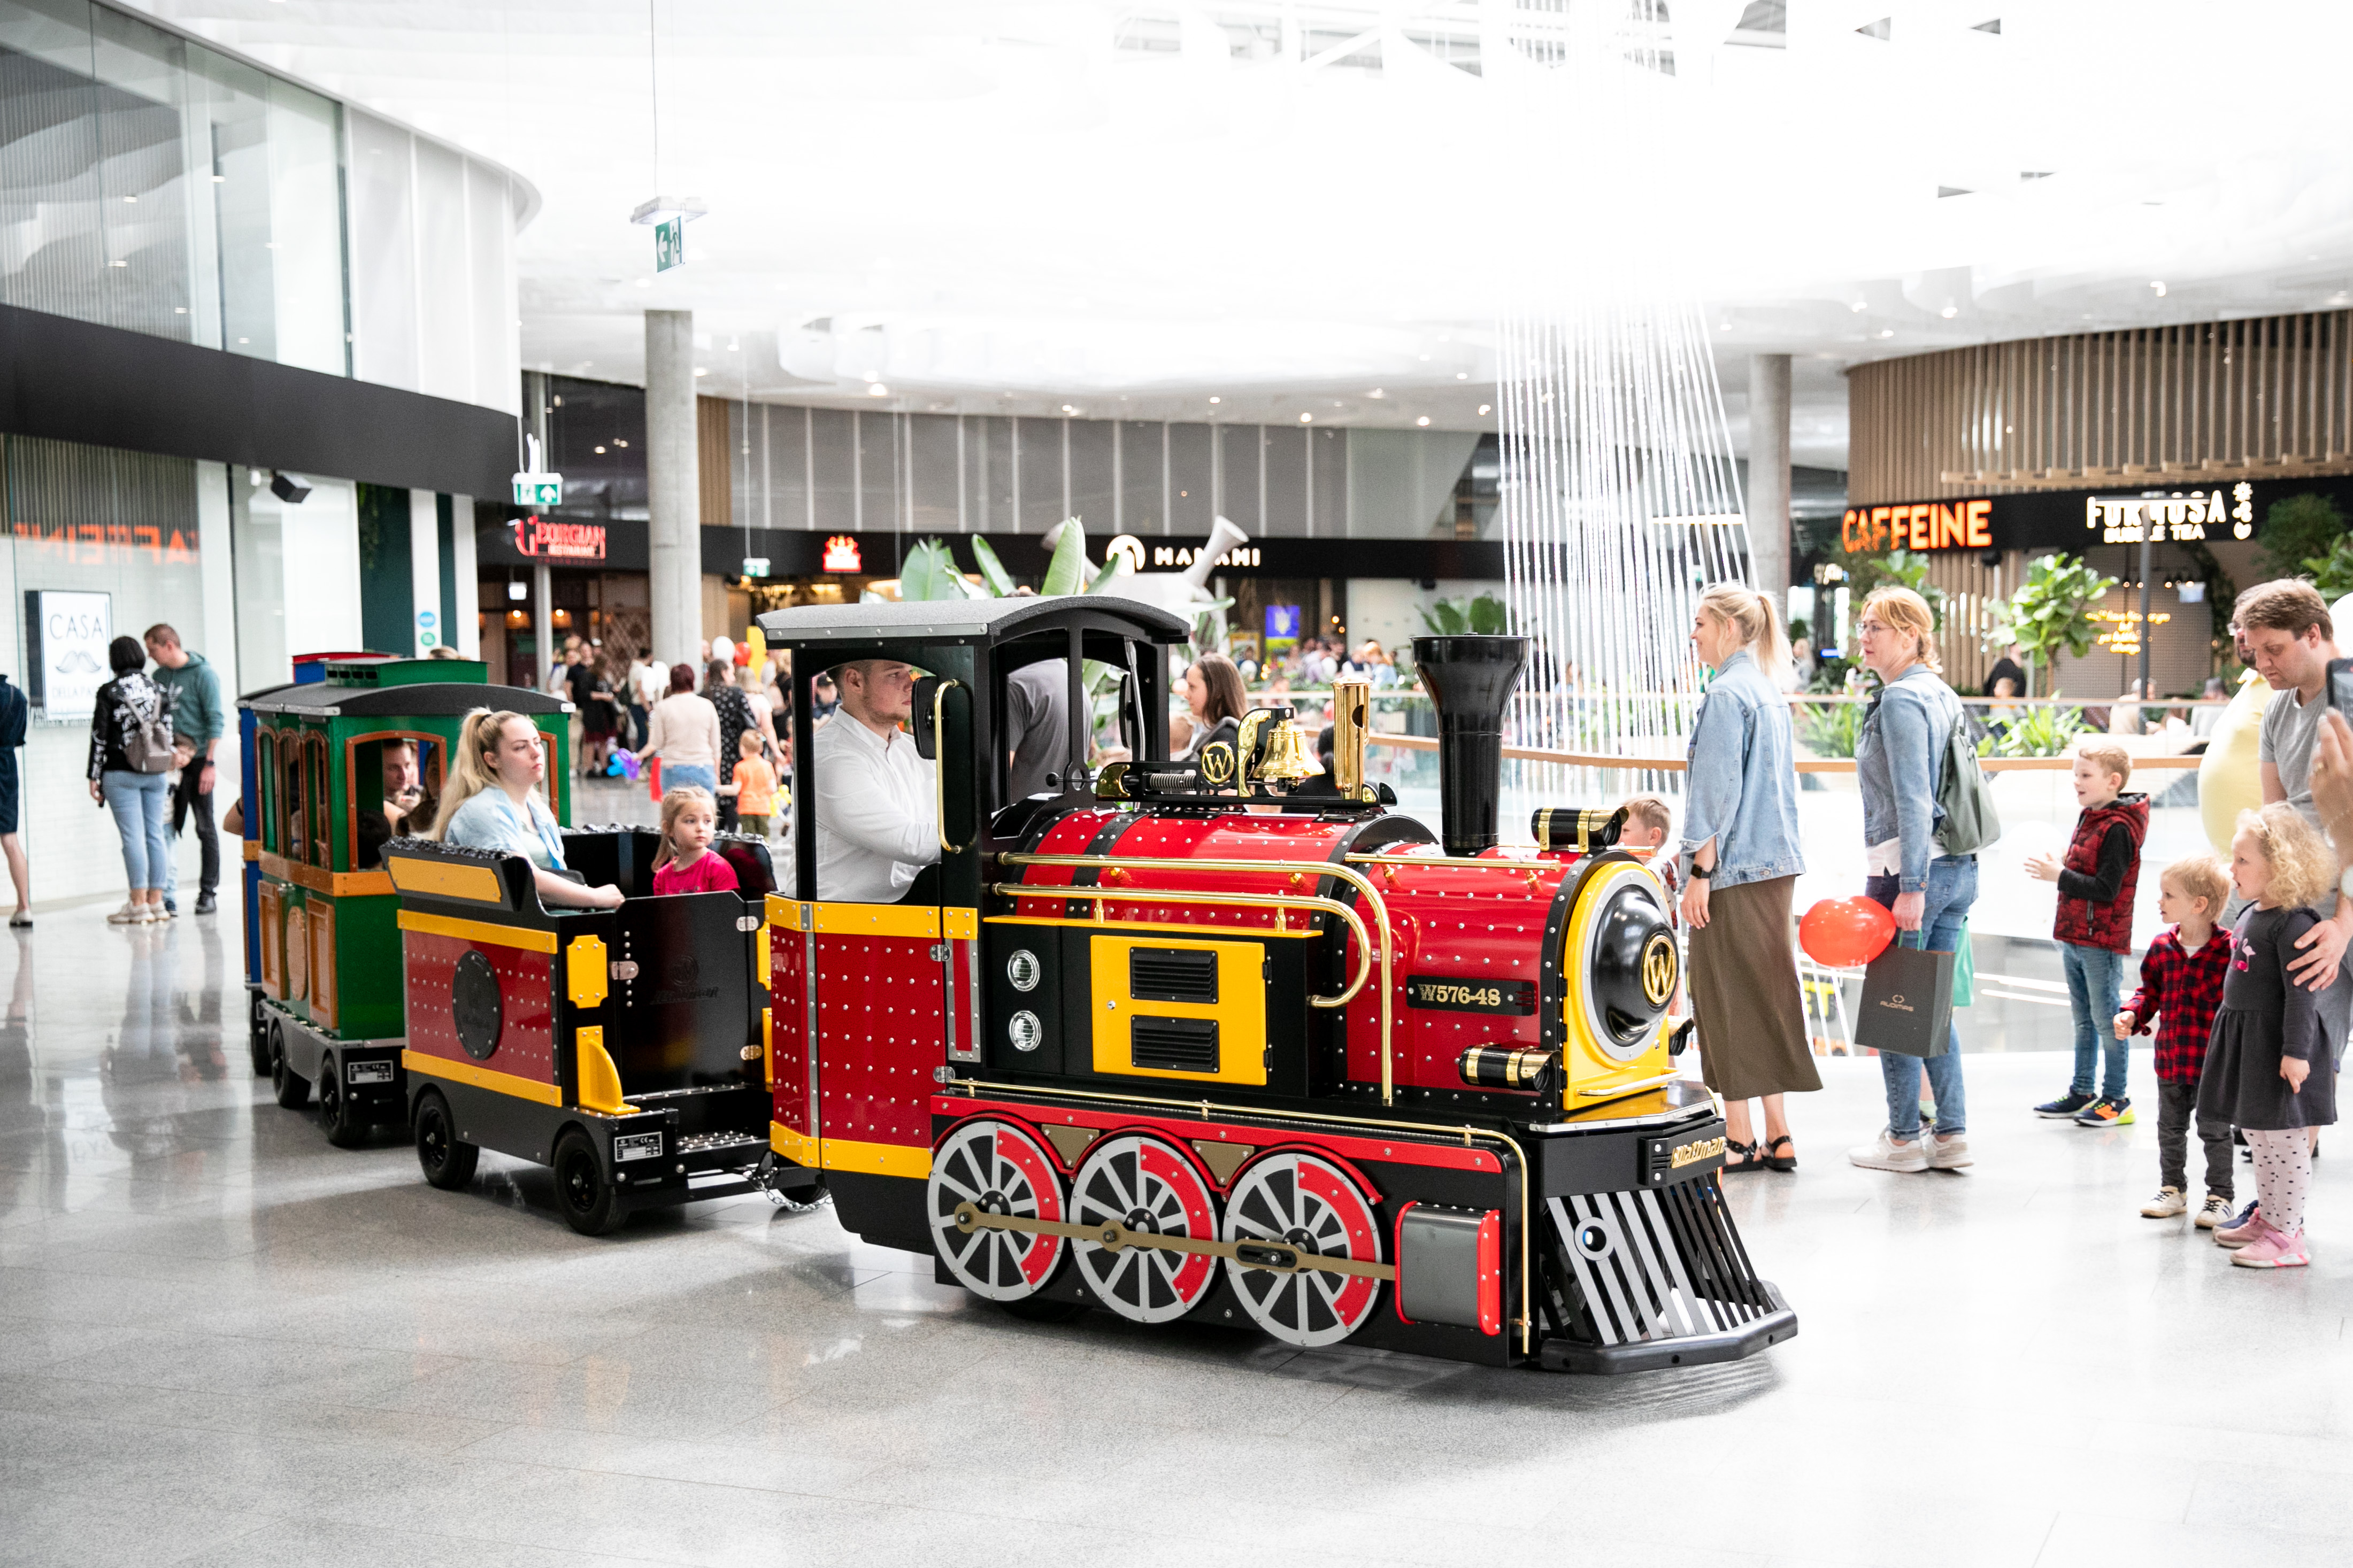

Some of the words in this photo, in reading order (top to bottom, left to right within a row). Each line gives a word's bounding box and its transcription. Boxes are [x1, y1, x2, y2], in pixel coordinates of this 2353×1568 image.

[1842, 500, 1992, 553] CAFFEINE
[2170, 523, 2205, 540] TEA
[50, 614, 104, 640] CASA
[1204, 746, 1233, 781] W
[1648, 944, 1675, 998] W
[1417, 983, 1501, 1006] W576-48
